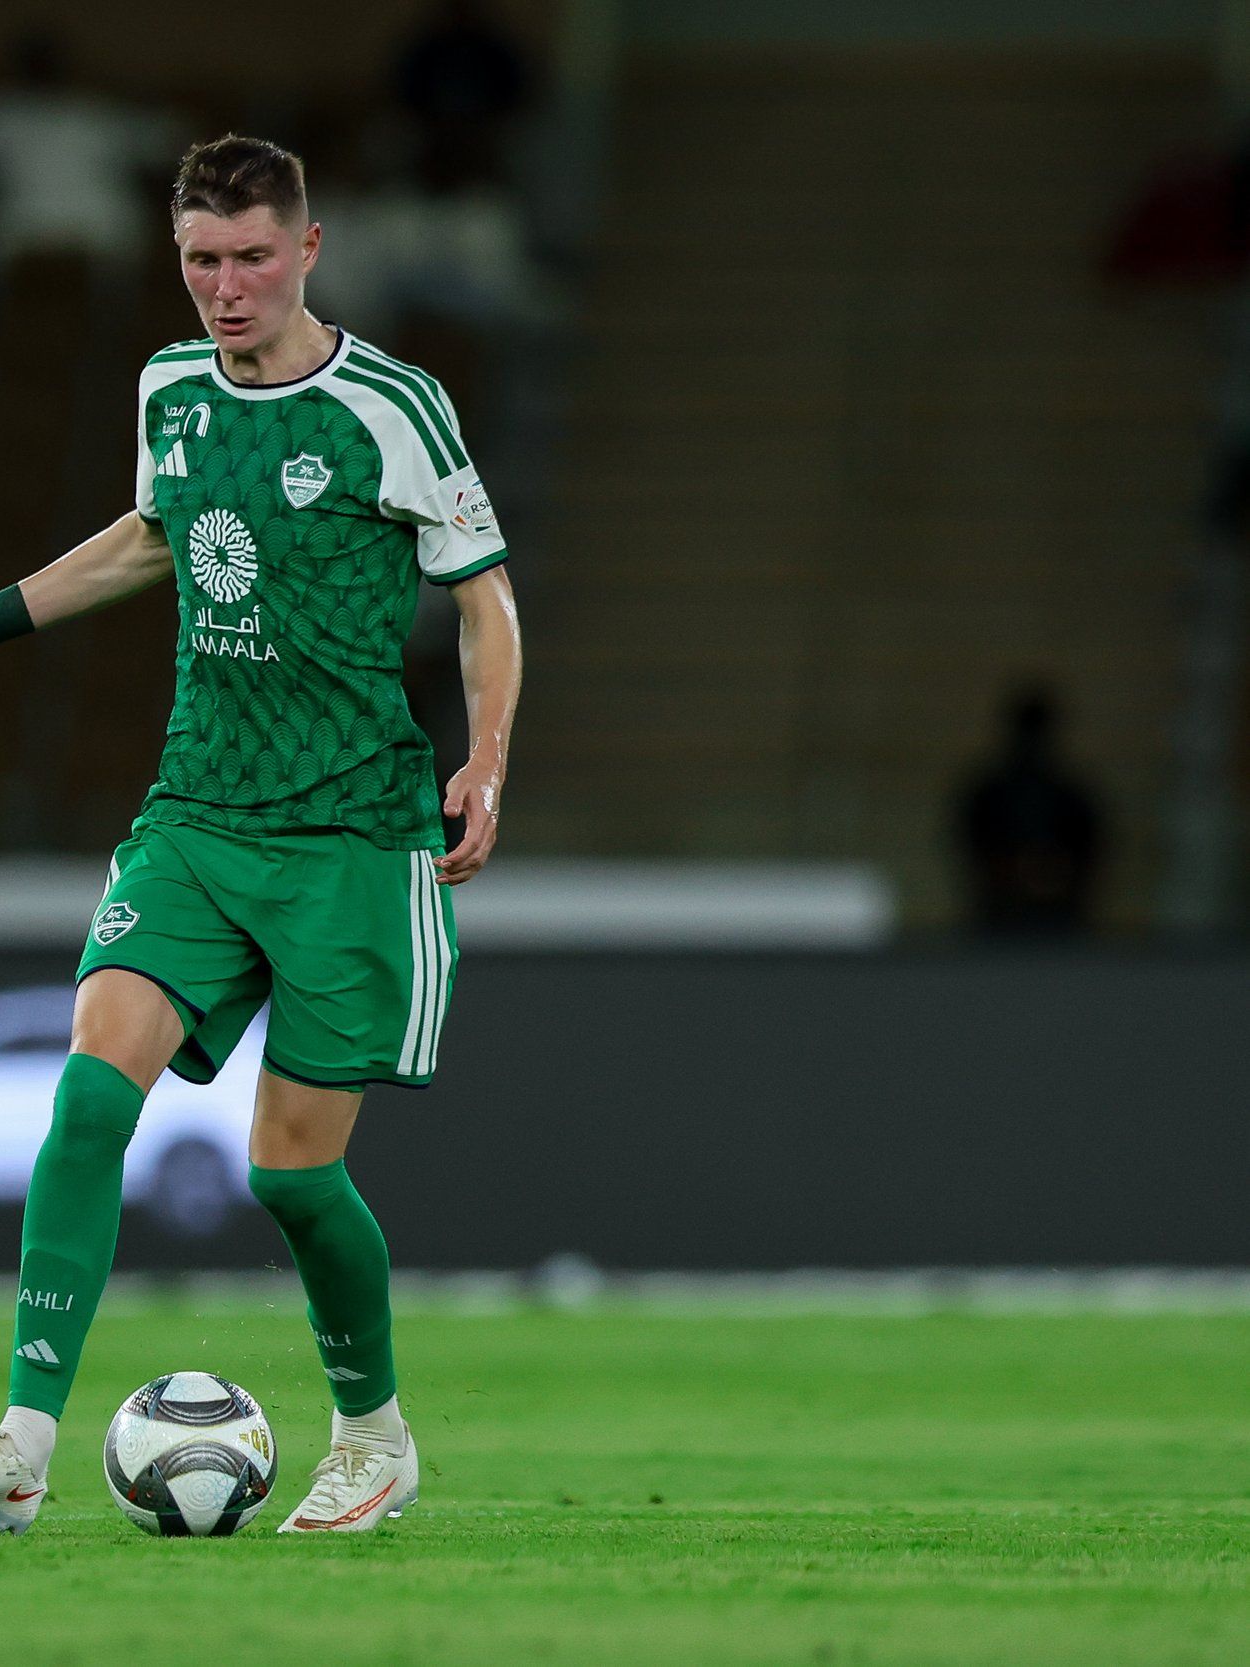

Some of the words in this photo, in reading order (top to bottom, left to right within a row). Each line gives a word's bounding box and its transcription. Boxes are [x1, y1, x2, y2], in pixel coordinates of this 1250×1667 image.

[470, 499, 491, 513] RSL
[19, 1287, 74, 1311] AHLI
[314, 1331, 352, 1347] HLI
